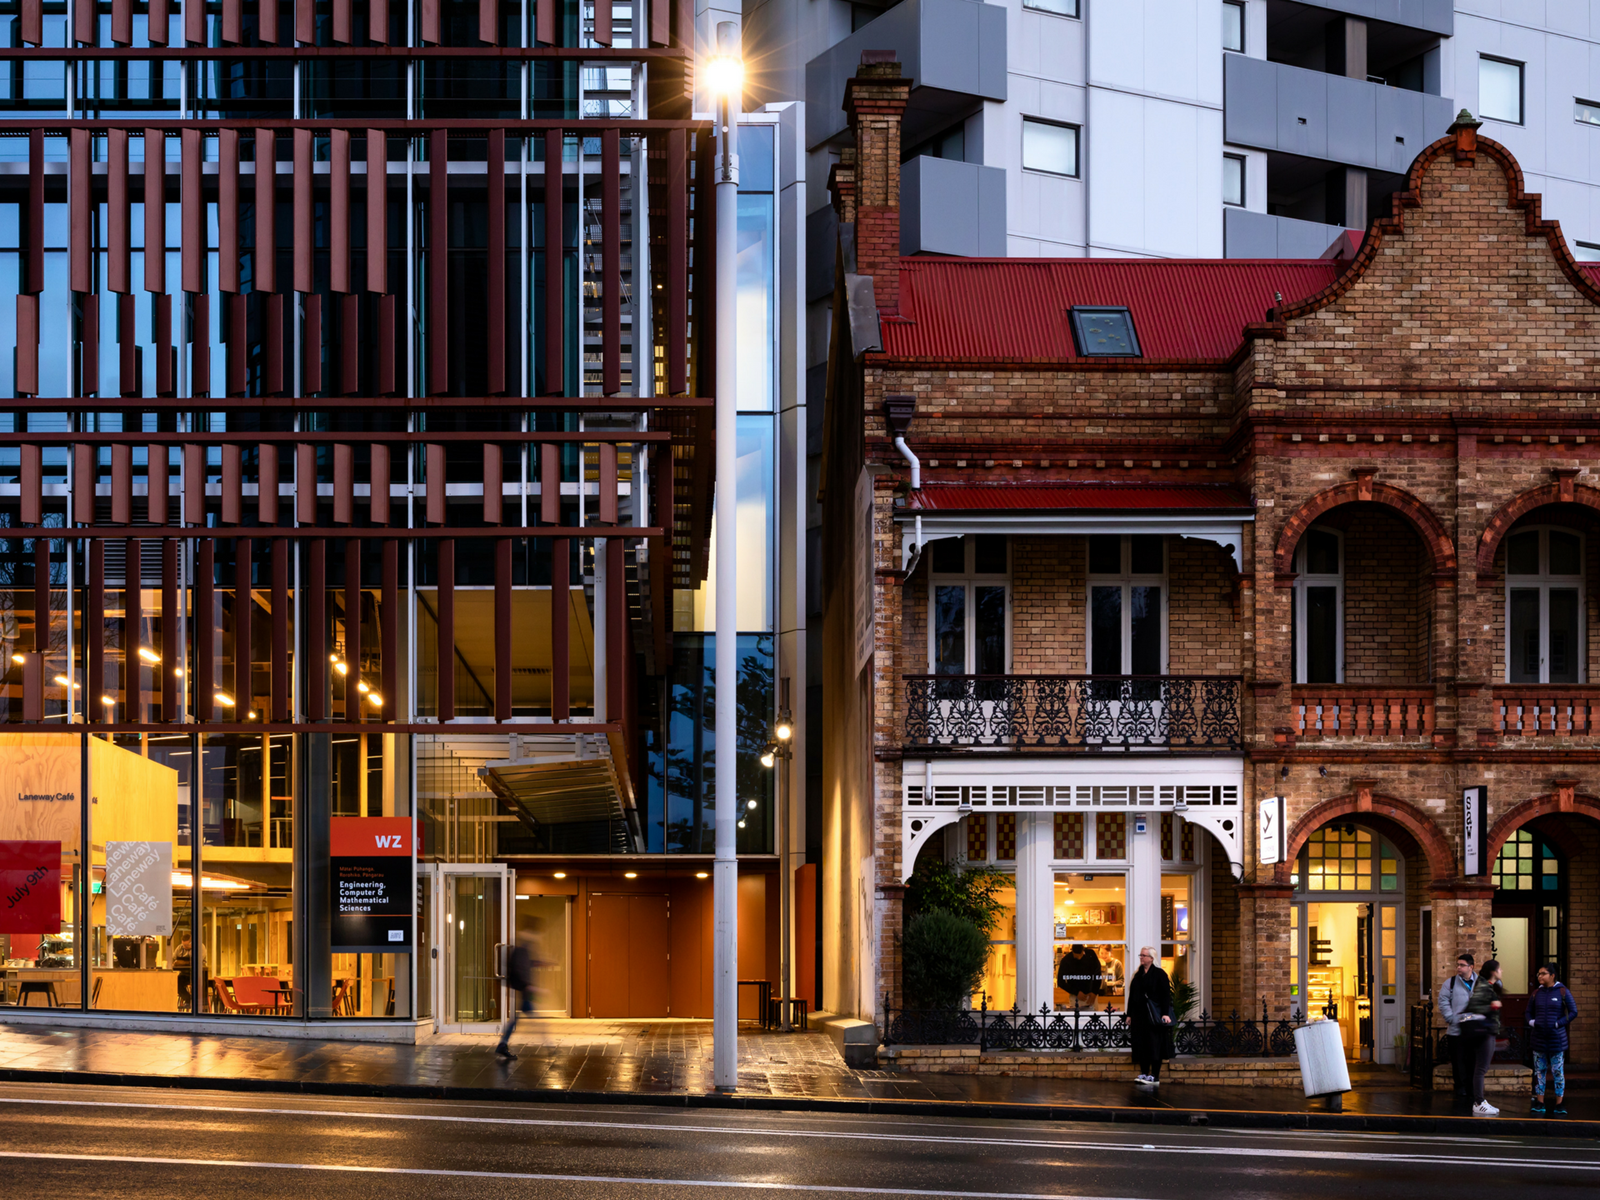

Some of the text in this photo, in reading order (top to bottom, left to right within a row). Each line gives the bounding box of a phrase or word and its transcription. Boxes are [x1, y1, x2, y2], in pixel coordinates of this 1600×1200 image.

[18, 793, 55, 802] Laneway
[375, 835, 402, 848] WZ
[109, 849, 160, 897] Laneway
[340, 881, 386, 889] Engineering,
[6, 865, 49, 909] July 9th
[132, 883, 160, 911] Café
[111, 904, 139, 932] Café
[121, 894, 149, 921] Café
